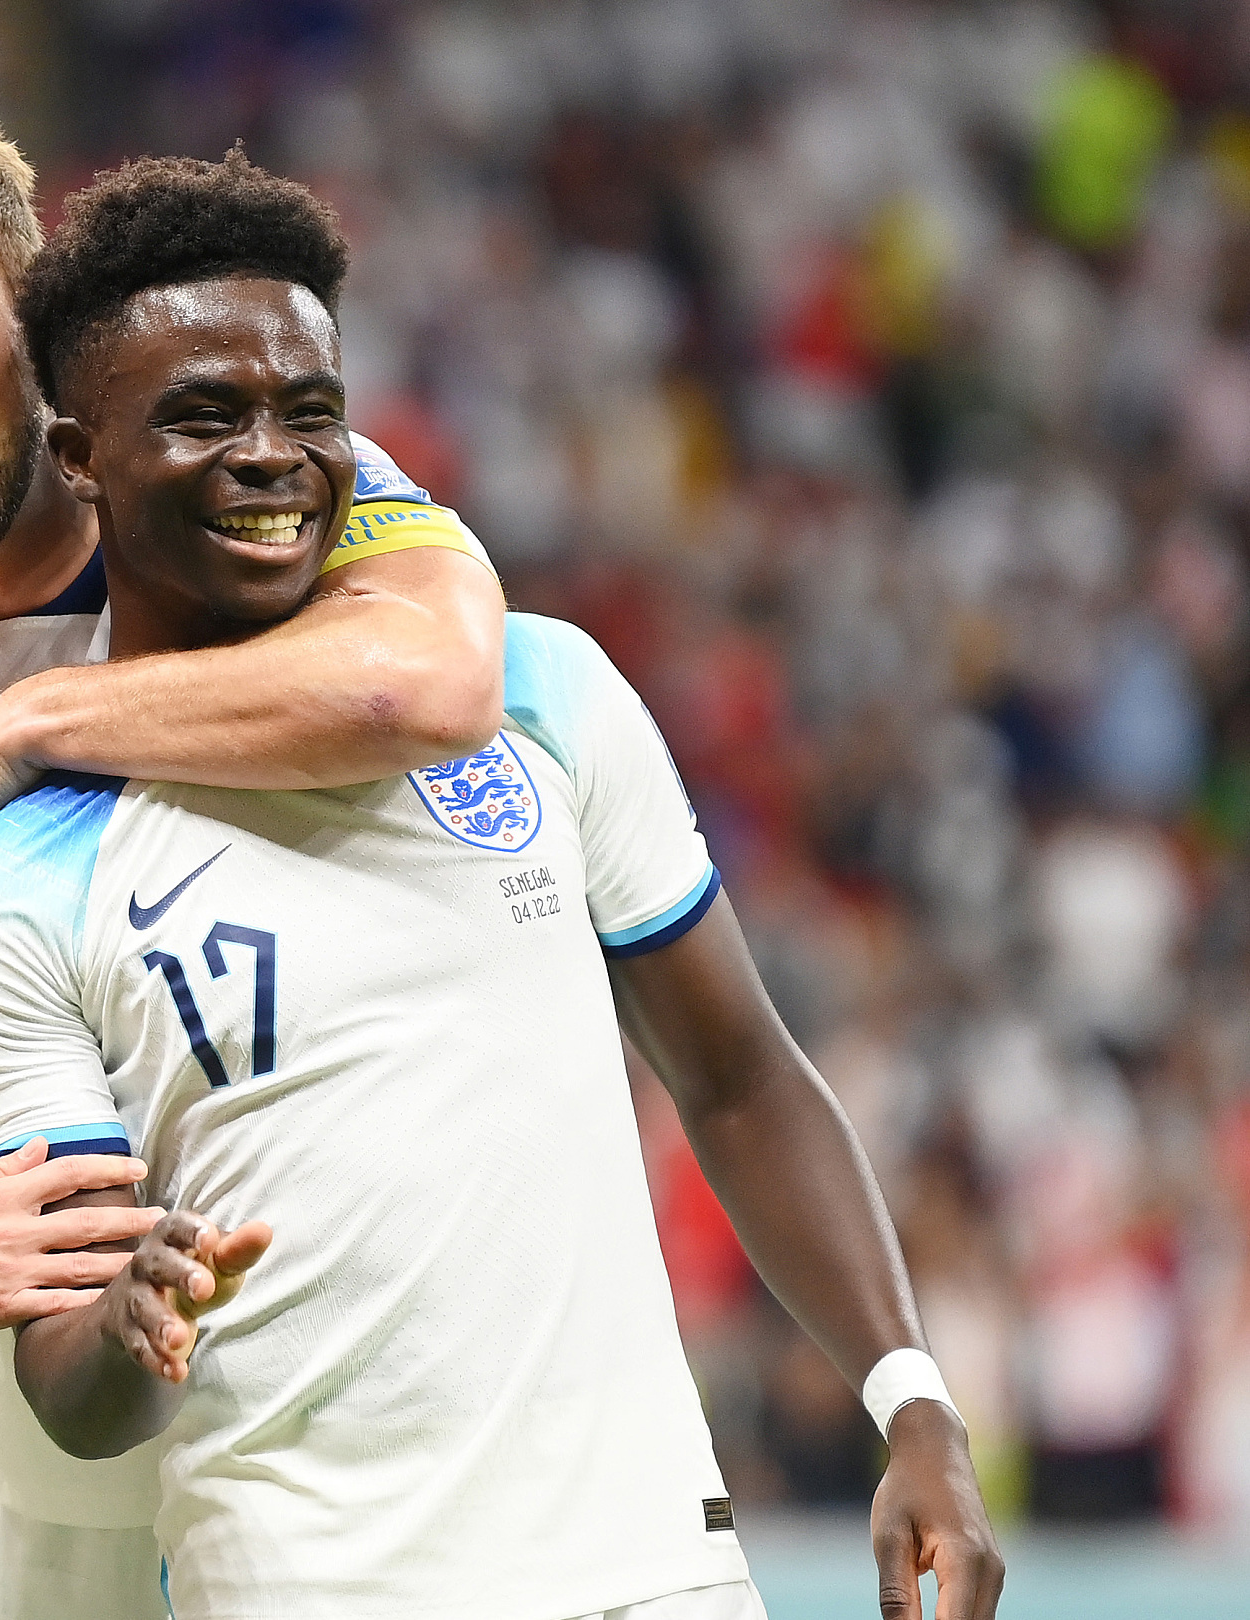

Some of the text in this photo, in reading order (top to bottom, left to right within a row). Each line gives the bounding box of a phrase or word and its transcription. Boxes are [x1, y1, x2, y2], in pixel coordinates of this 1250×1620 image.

[498, 866, 556, 898] SENEGAL
[511, 893, 561, 924] 04.12.22
[141, 919, 279, 1089] 17
